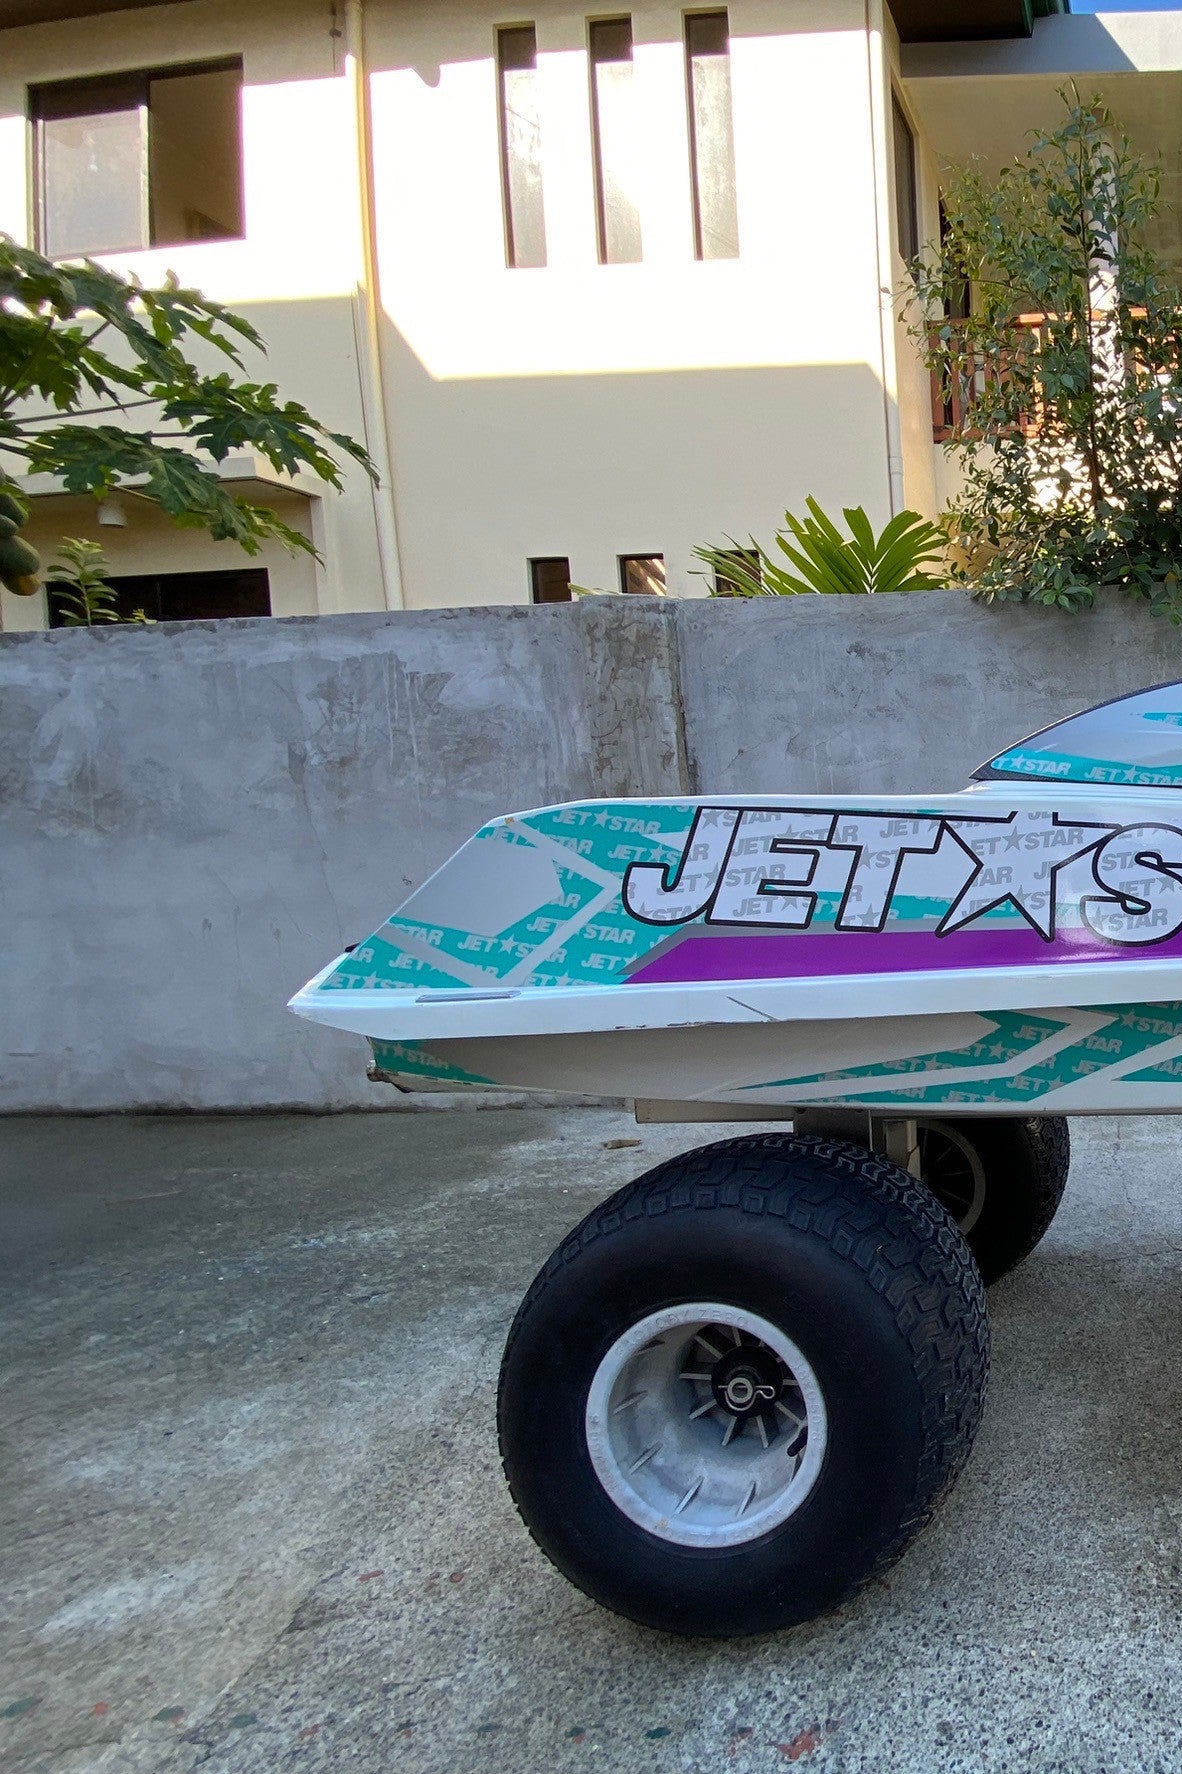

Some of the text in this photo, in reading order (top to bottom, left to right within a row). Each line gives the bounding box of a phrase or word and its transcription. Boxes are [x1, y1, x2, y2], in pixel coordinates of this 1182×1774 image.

[1024, 758, 1072, 776] STAR
[1084, 766, 1123, 782] JET
[552, 810, 662, 835] JET STAR
[880, 819, 920, 839] JET
[1024, 827, 1084, 850] STAR
[608, 845, 648, 861] JET
[622, 805, 940, 933] JET
[725, 863, 787, 887] STAR
[733, 897, 779, 918] JET
[457, 935, 497, 953] JET
[583, 924, 636, 945] STAR
[581, 953, 619, 971] JET
[1006, 1075, 1046, 1092] JET
